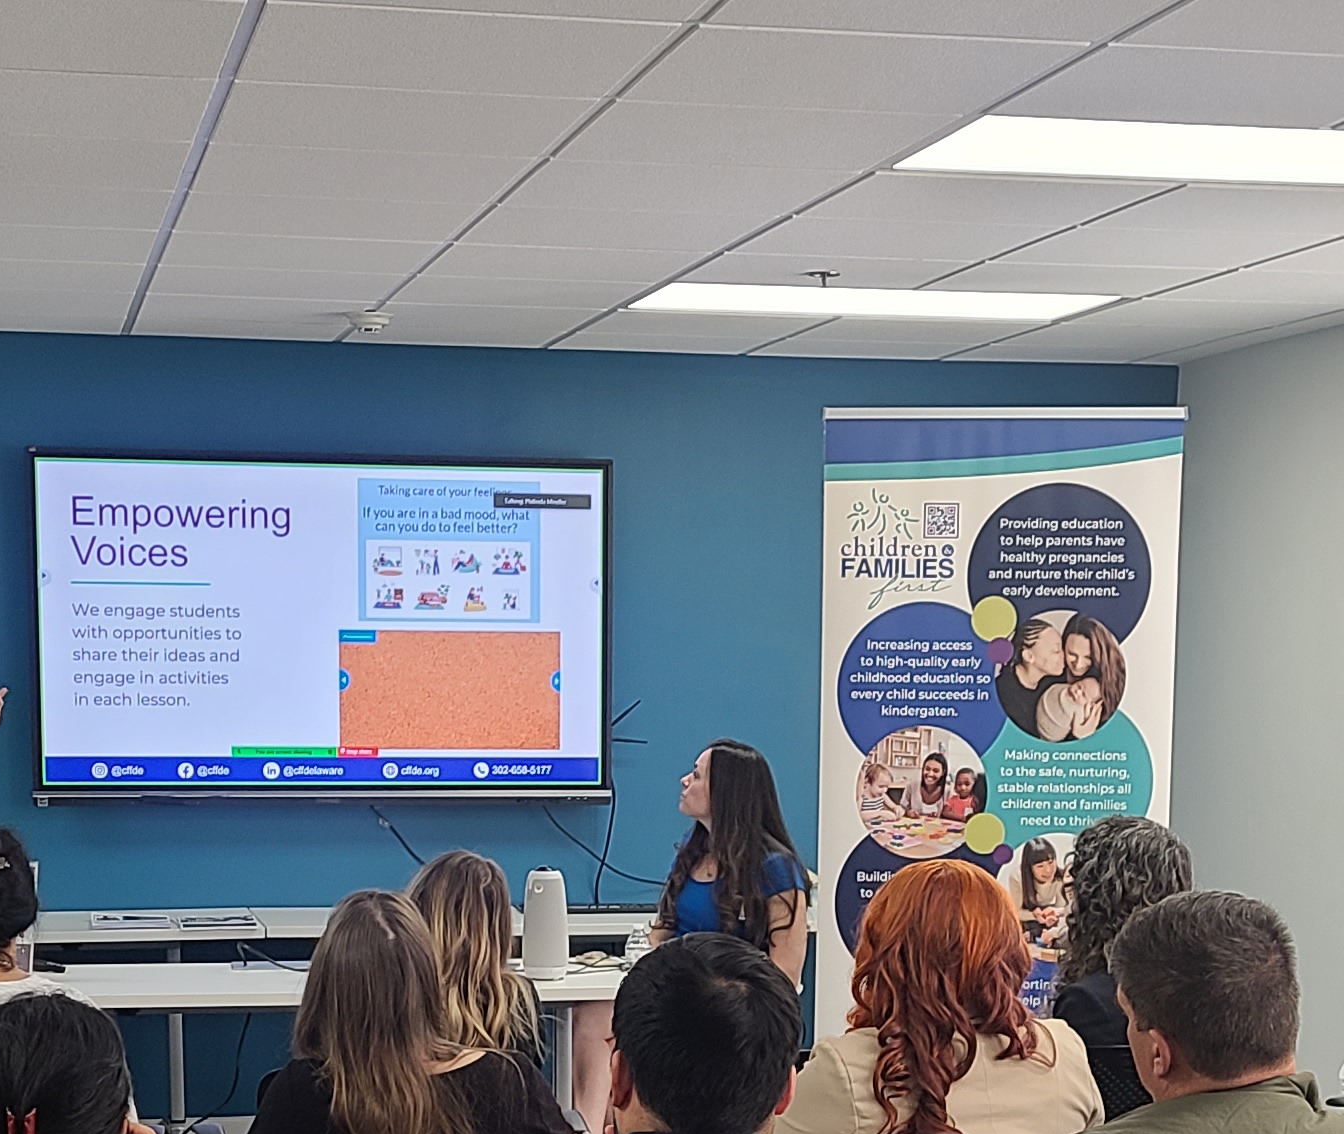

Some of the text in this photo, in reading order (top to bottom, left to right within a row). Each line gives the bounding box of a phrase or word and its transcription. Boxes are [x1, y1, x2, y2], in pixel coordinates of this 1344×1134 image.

[378, 485, 411, 498] Taking
[413, 488, 438, 497] care
[438, 486, 448, 497] of
[449, 489, 472, 499] your
[71, 495, 291, 537] Empowering
[363, 507, 530, 521] If you are in a bad mood, what
[375, 522, 518, 535] can you do to feel better?
[999, 518, 1123, 531] Providing education
[840, 536, 936, 557] children
[1000, 534, 1125, 549] to help parents have
[70, 535, 189, 567] Voices
[1000, 551, 1124, 566] healthy pregnancies
[840, 558, 955, 579] FAMILIES
[988, 568, 1135, 580] and nurture their child's
[867, 578, 952, 610] first
[1002, 585, 1120, 599] early development.
[72, 603, 240, 620] We engage students
[72, 626, 242, 642] with opportunities to
[867, 639, 973, 653] Increasing access
[72, 648, 240, 662] share their ideas and
[860, 655, 982, 671] to high-quality early
[73, 670, 229, 687] engage in activities
[849, 672, 991, 684] childhood education so
[74, 692, 190, 707] in each lesson.
[851, 689, 989, 703] every child succeeds in
[881, 705, 959, 719] kindergaten.
[1005, 750, 1127, 763] Making connections
[1000, 766, 1131, 781] to the safe, nurturing,
[997, 782, 1131, 797] stable relationships all
[1001, 798, 1128, 810] children and families
[1020, 815, 1098, 827] need to thriv
[857, 871, 897, 883] Buildi
[860, 887, 873, 898] to
[1022, 978, 1052, 991] ortin
[1022, 994, 1041, 1008] elp
